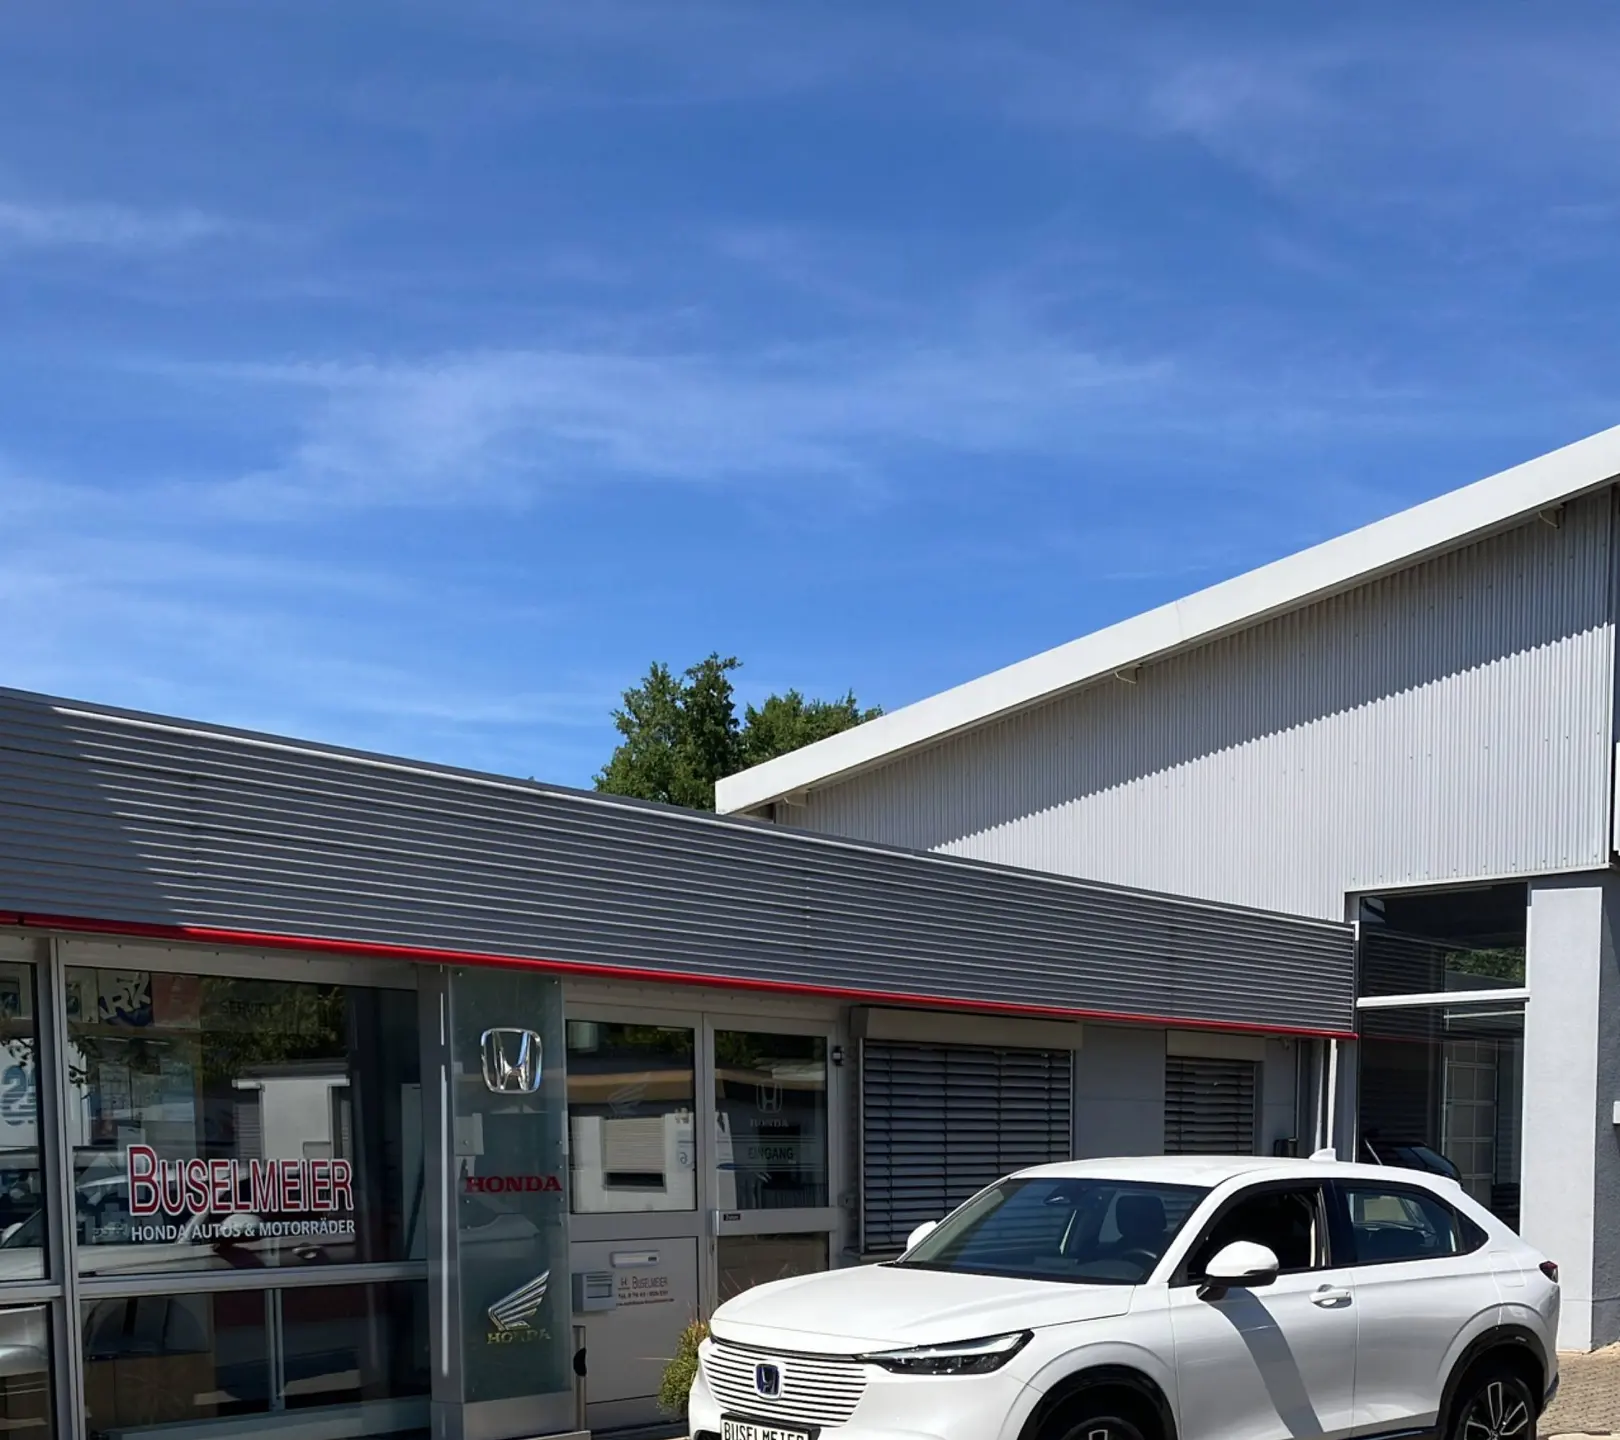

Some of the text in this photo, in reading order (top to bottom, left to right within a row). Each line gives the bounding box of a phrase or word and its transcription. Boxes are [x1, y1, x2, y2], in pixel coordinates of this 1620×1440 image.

[127, 1144, 354, 1216] BUSELMEIER
[465, 1175, 562, 1193] HONDA
[131, 1217, 355, 1241] HONDA AUTOS & MOTORRÄDER
[486, 1328, 552, 1345] HONDA
